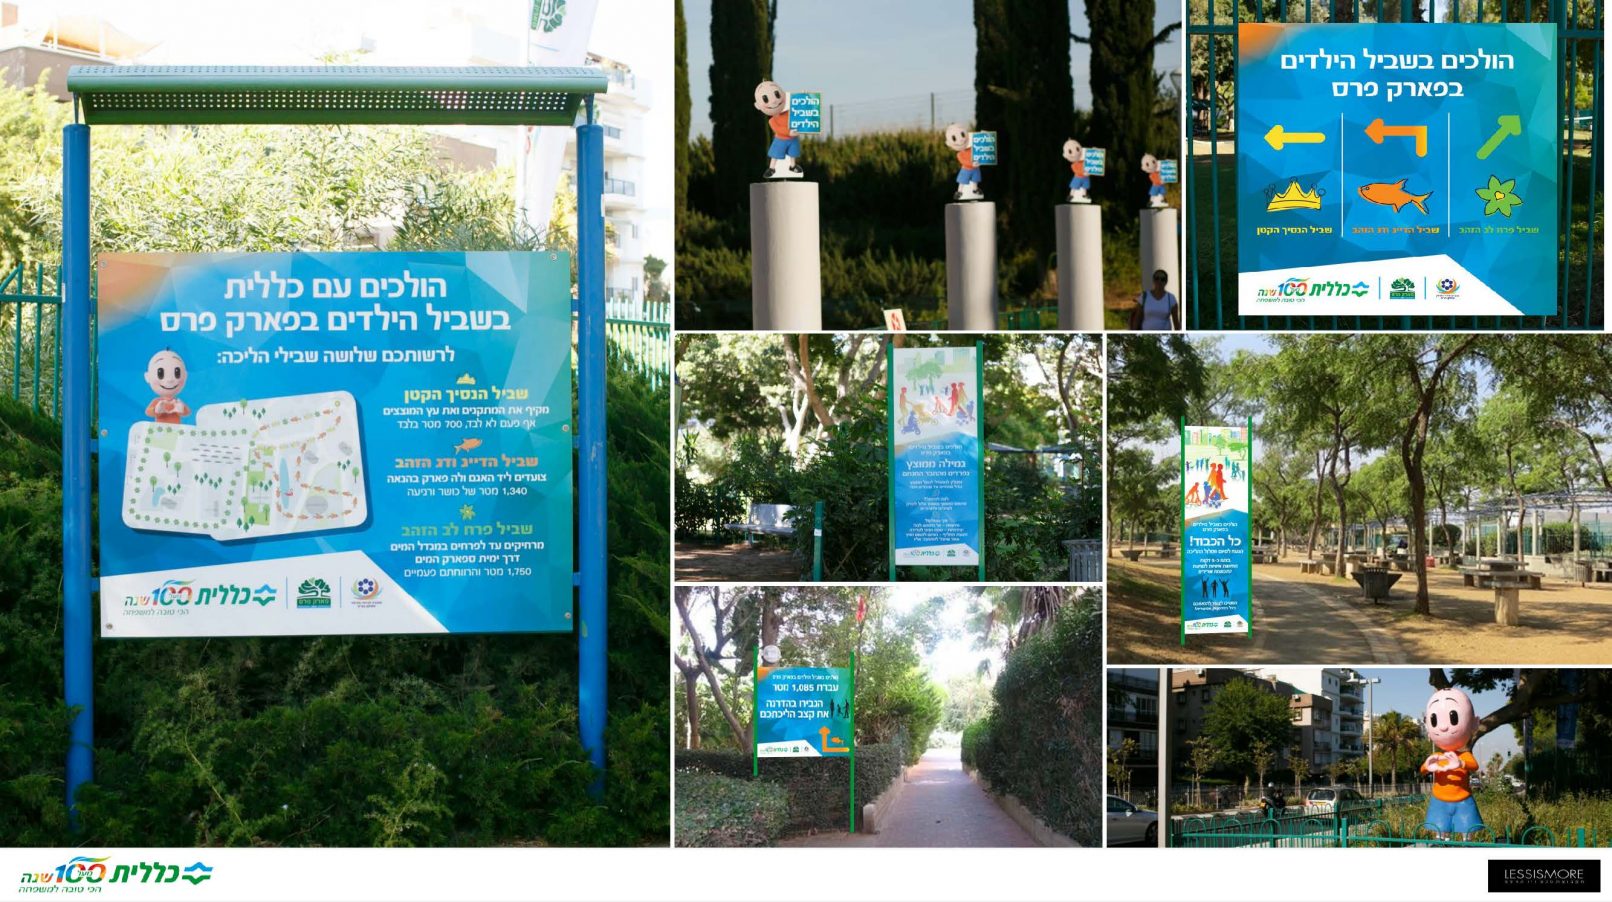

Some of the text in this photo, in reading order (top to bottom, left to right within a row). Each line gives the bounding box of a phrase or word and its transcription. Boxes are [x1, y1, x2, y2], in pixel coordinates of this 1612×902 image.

[1280, 48, 1514, 70] הולכים בשביל הילדים
[1332, 81, 1464, 102] בפארק פרס
[791, 96, 820, 106] הולכים
[791, 108, 819, 116] בשביל
[791, 119, 819, 128] הילדים
[1256, 225, 1333, 236] שביל הנסיך הקטן
[224, 270, 447, 299] הולכים עם כללית
[1278, 282, 1308, 296] 100
[1309, 281, 1350, 296] כללית
[160, 303, 512, 338] בשביל הילדים בפארק פרס
[217, 346, 455, 364] לרשותכם שלושה שבילי הליכה:
[404, 385, 529, 404] שביל הנסיך הקטן
[383, 406, 550, 416] מקיף את המתקנים ואת עץ המוצצים
[398, 418, 420, 429] בלבד
[422, 420, 442, 428] מטר
[445, 420, 462, 428] 700
[486, 418, 497, 428] לא
[500, 420, 520, 428] פעם
[522, 419, 536, 430] אף
[394, 454, 538, 468] שביל הדייג ודג הזהב
[387, 475, 418, 483] בהנאה
[422, 474, 448, 484] פארק
[468, 474, 494, 482] האגם
[496, 472, 510, 482] ליד
[514, 474, 547, 482] צועדים
[438, 488, 460, 496] כושר
[462, 486, 476, 496] של
[480, 488, 498, 496] מטר
[502, 488, 528, 496] 1,340
[402, 522, 534, 536] שביל פרח לב הזהב
[1190, 534, 1242, 546] כל הכבוד!
[390, 540, 544, 552] מרחיקים עד לפרחים במגדל המים
[415, 554, 520, 566] דרך ימית ספארק המים
[484, 568, 504, 576] מטר
[508, 568, 532, 576] 1,750
[124, 584, 251, 606] כללית 100 שנה
[772, 684, 788, 692] מטר
[792, 684, 814, 692] 1,085
[798, 711, 815, 720] קצב
